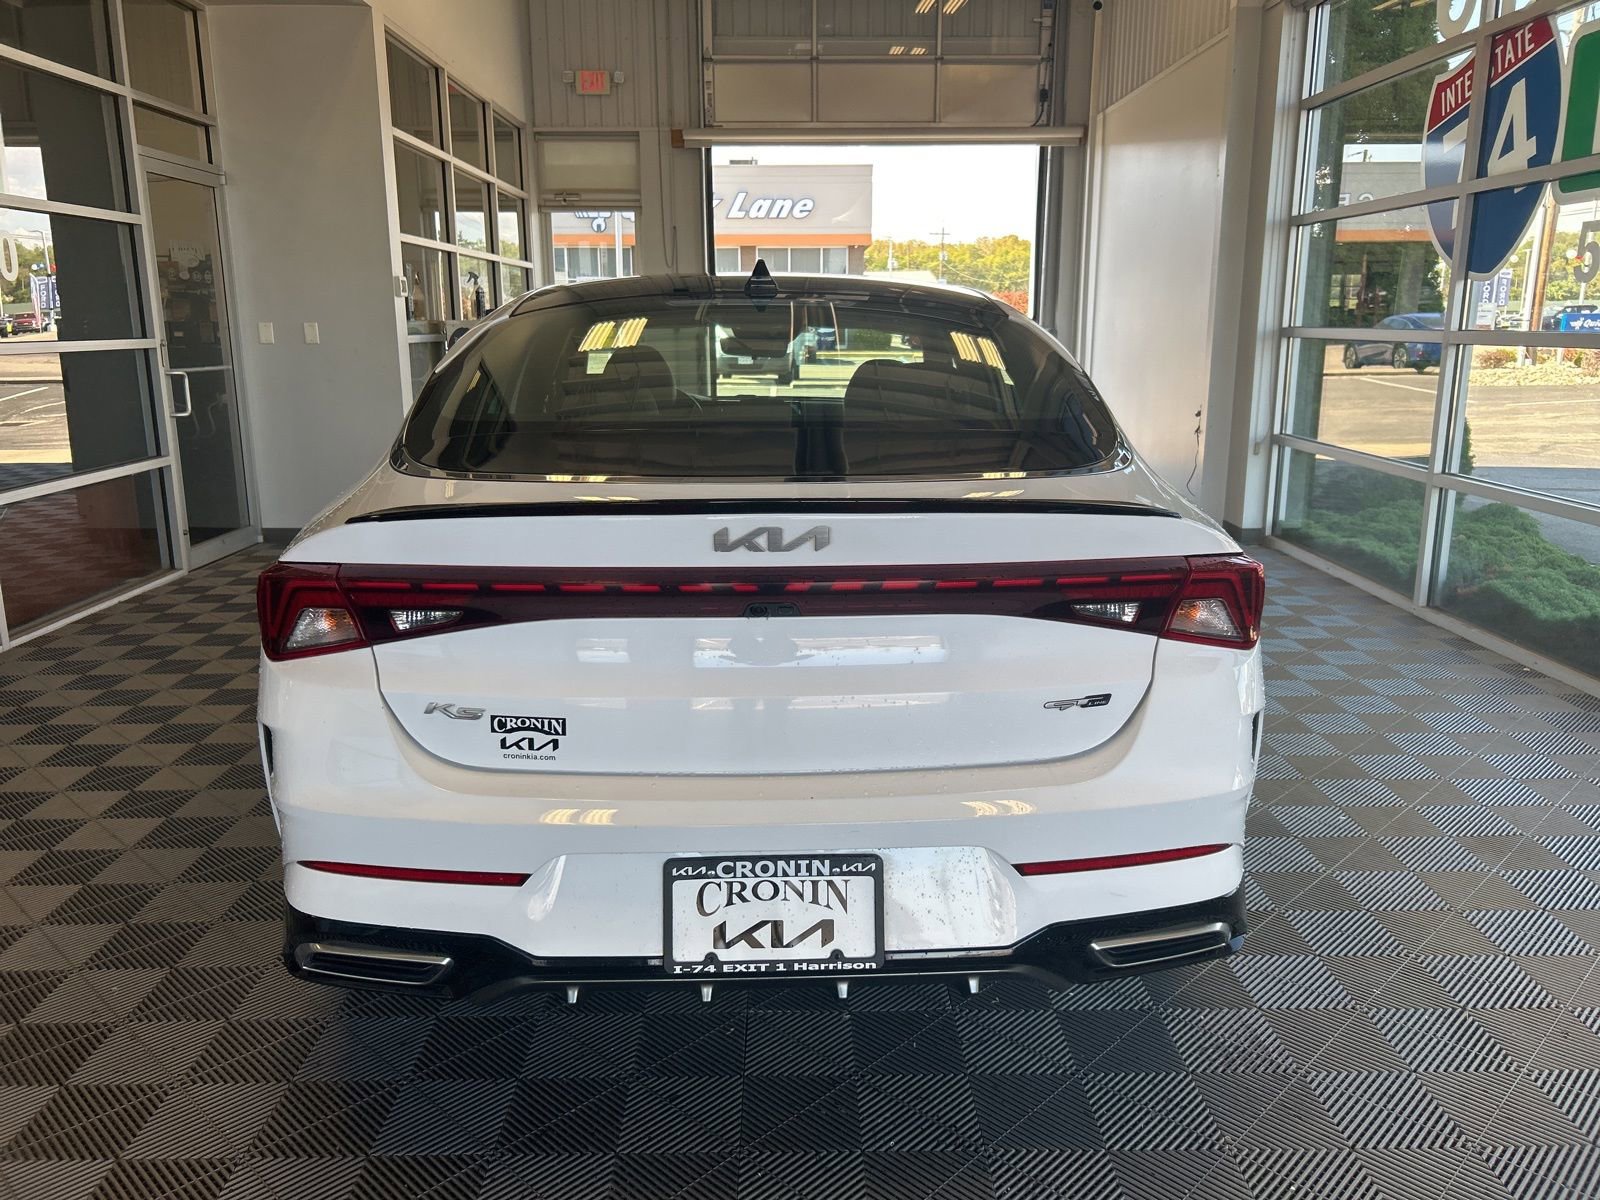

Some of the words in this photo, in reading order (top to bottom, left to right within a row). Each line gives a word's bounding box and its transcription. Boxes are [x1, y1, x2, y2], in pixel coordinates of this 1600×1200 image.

[1441, 22, 1535, 117] INTETATE
[580, 70, 607, 93] EXIT
[726, 191, 815, 220] Lane
[493, 716, 564, 735] CRONIN
[500, 736, 560, 752] KIA
[503, 752, 557, 761] croninkia.com
[716, 859, 831, 878] CRONIN
[696, 879, 851, 918] CRONIN
[713, 918, 835, 950] KIA
[673, 964, 717, 974] I-74
[723, 963, 770, 973] EXIT
[775, 962, 787, 971] 1
[793, 961, 877, 971] Harrison
